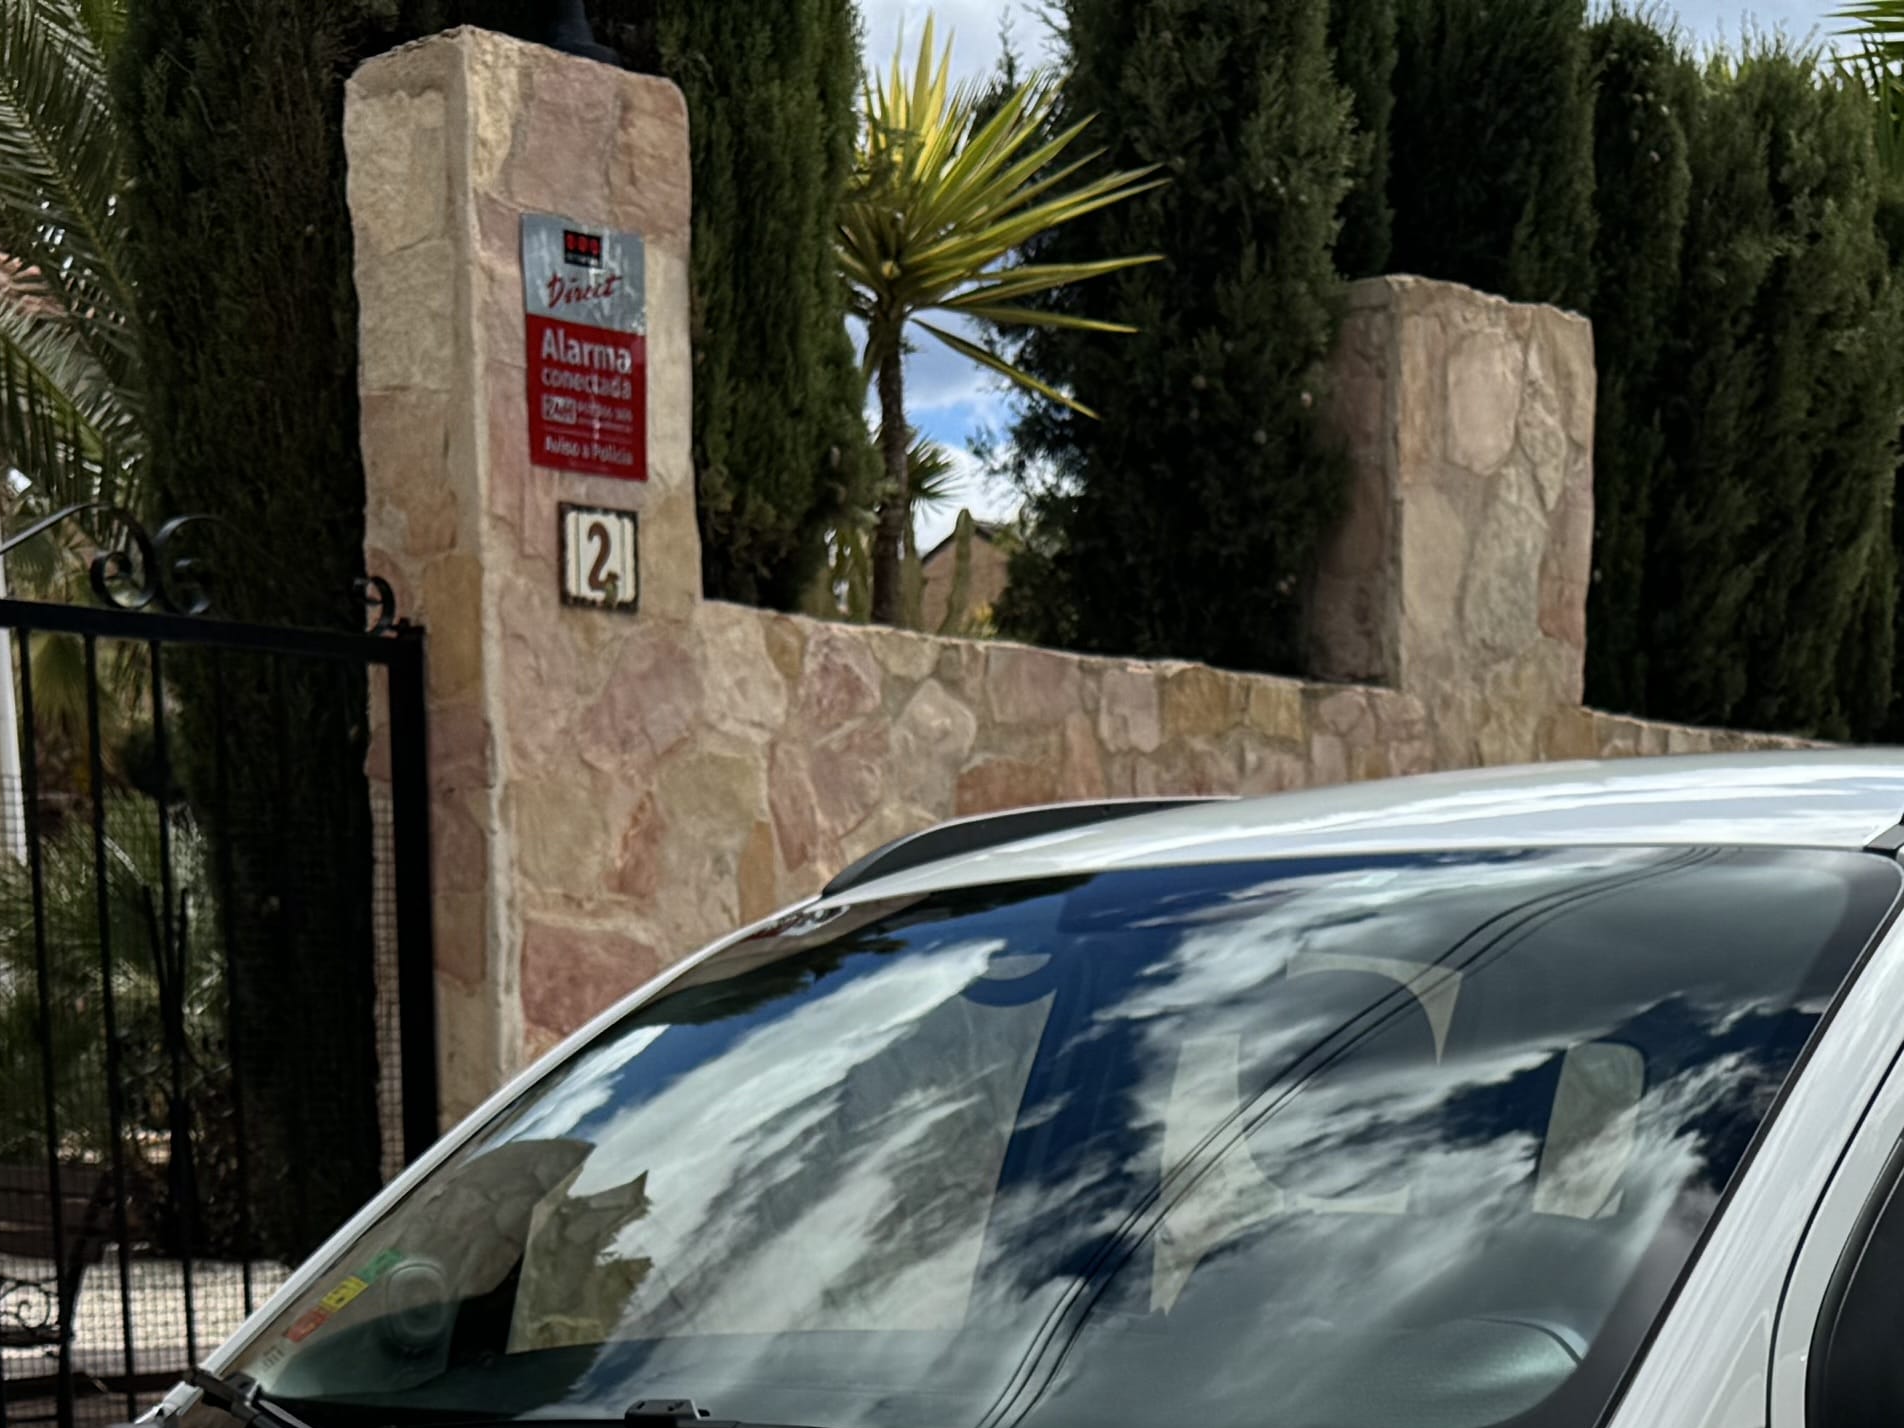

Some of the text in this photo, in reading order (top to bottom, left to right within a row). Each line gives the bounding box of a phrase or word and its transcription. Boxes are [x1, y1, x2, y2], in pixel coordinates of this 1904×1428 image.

[546, 273, 622, 309] Direct
[542, 328, 632, 374] Alarma
[541, 367, 632, 400] conectada
[587, 521, 615, 592] 2
